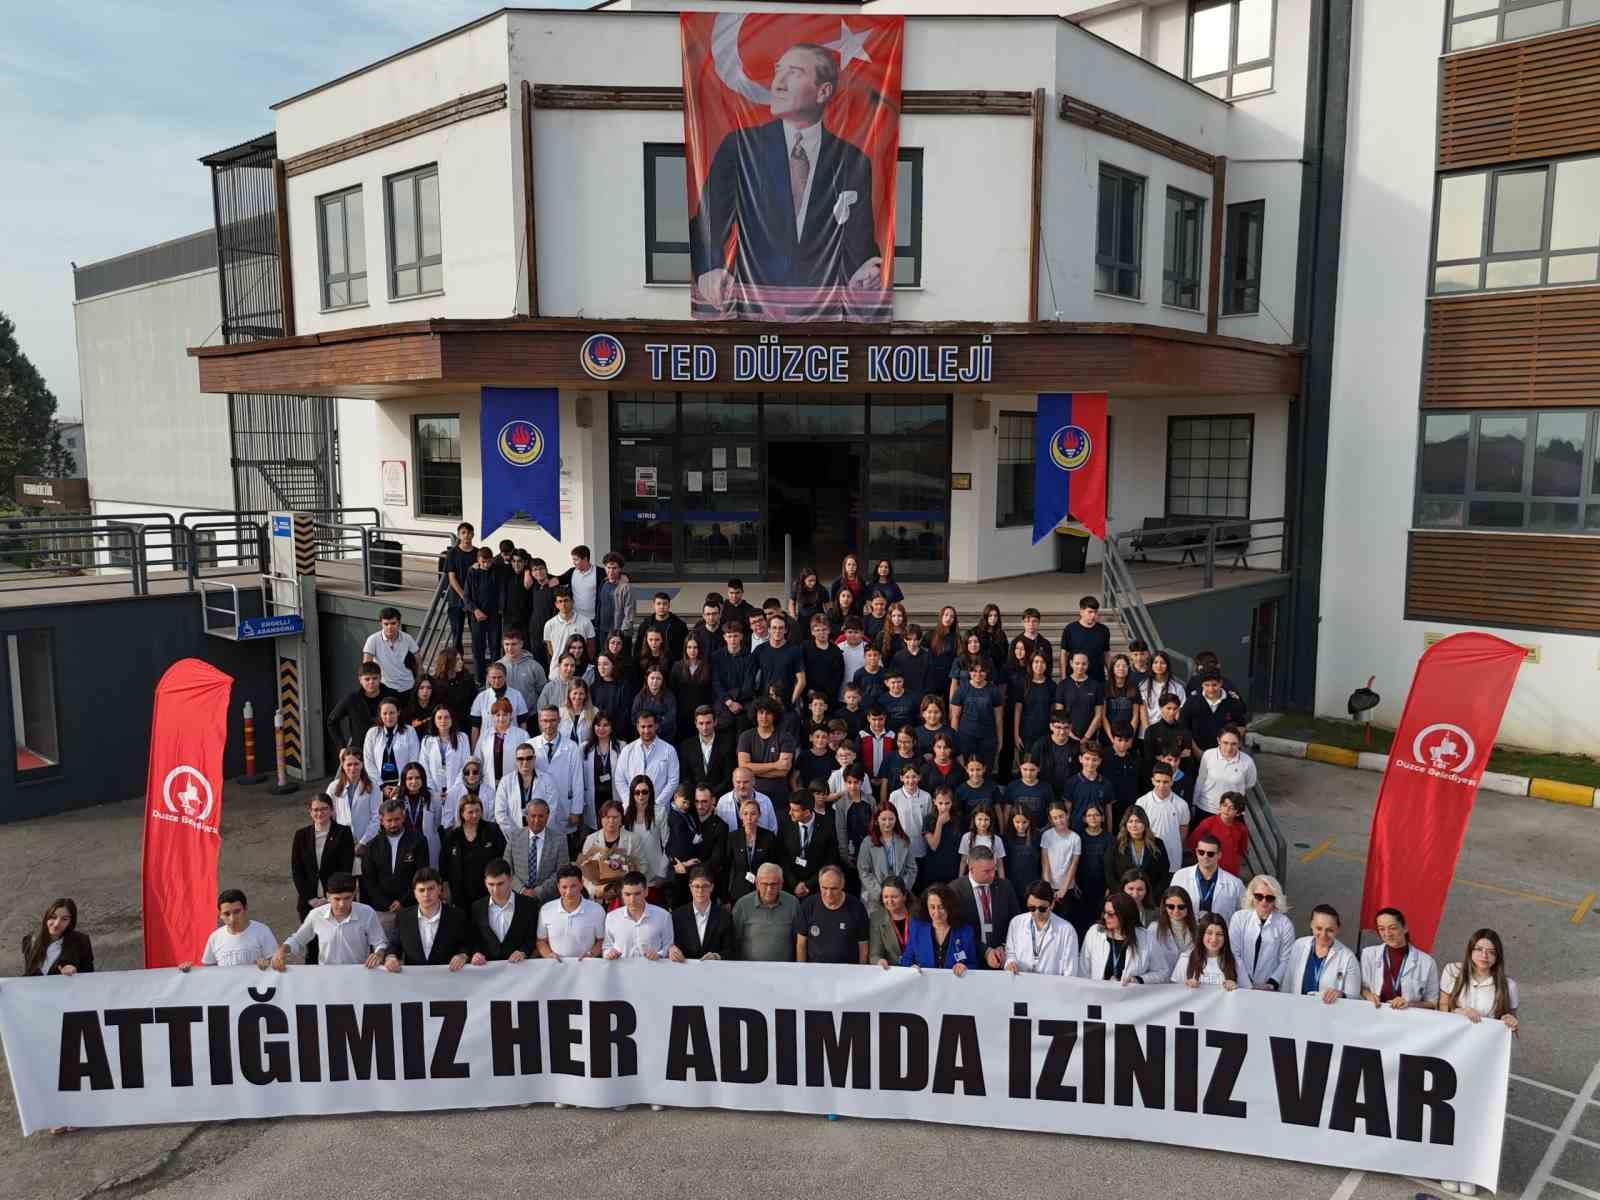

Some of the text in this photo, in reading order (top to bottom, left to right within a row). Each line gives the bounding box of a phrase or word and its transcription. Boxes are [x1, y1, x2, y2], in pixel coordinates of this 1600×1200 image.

[645, 335, 992, 382] TED DÜZCE KOLEJİ
[58, 986, 1458, 1146] ATTIĞIMIZ HER ADIMDA İZİNİZ VAR
